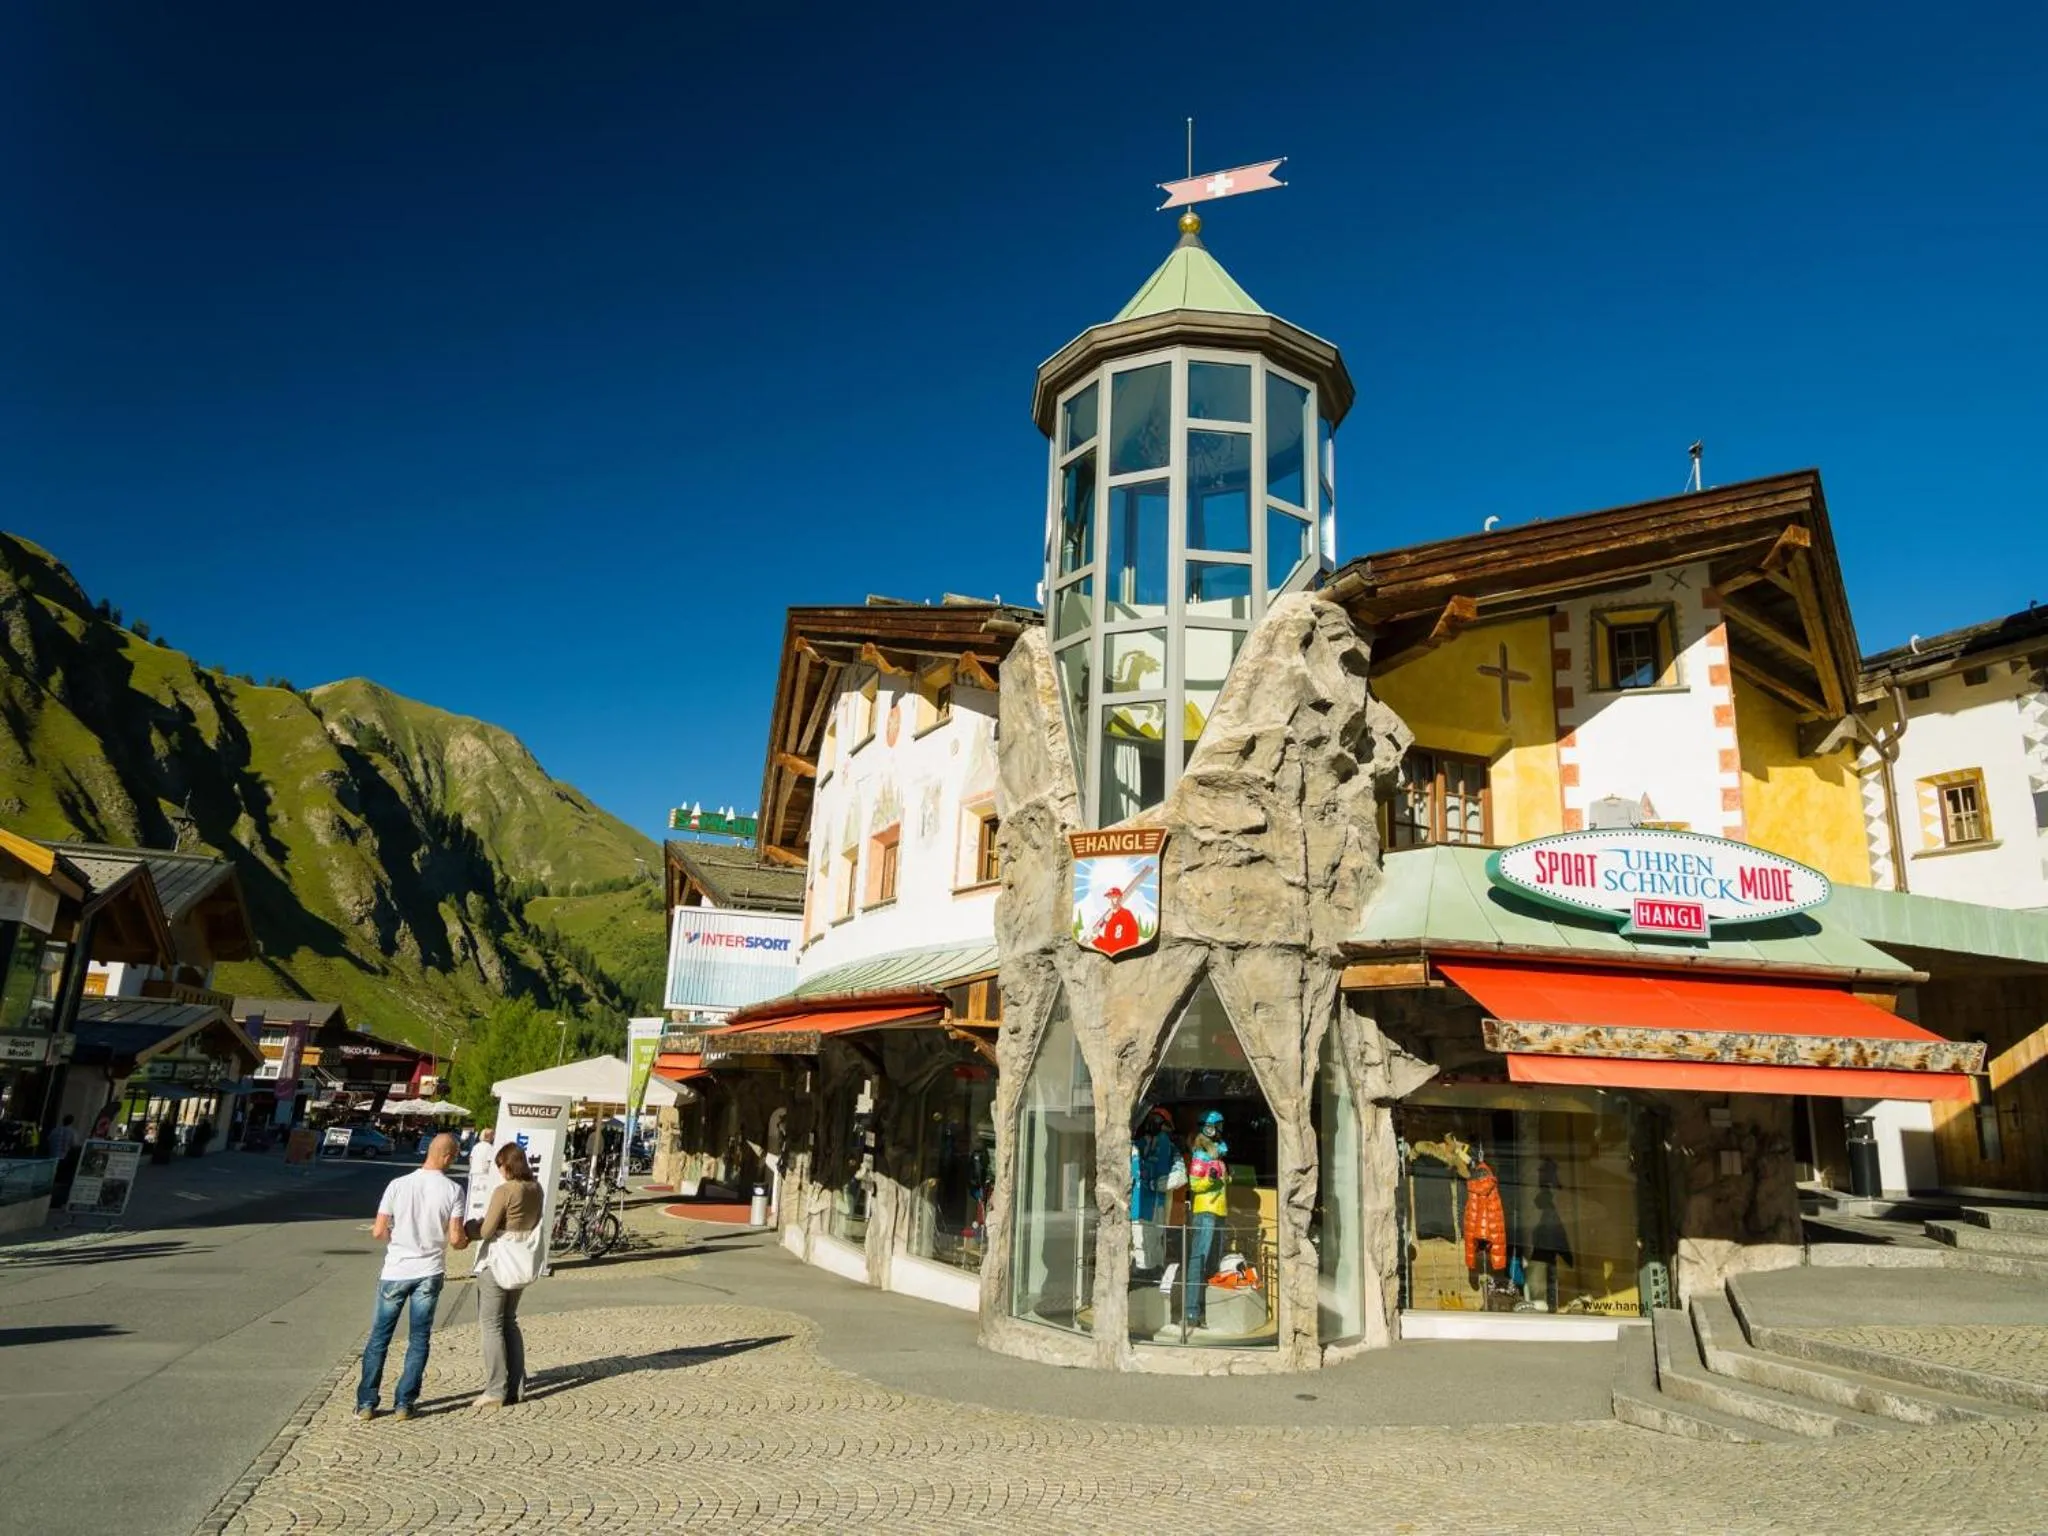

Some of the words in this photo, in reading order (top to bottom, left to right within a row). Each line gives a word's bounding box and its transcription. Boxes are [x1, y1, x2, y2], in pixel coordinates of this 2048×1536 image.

[1086, 833, 1144, 852] HANGL
[1606, 850, 1713, 876] UHREN
[1535, 850, 1597, 887] SPORT
[1604, 869, 1748, 904] SCHMUCK
[1739, 866, 1795, 902] MODE
[1639, 903, 1701, 928] HANGL
[701, 931, 791, 951] INTERSPORT
[1114, 924, 1123, 939] 8
[518, 1106, 551, 1116] HANGL
